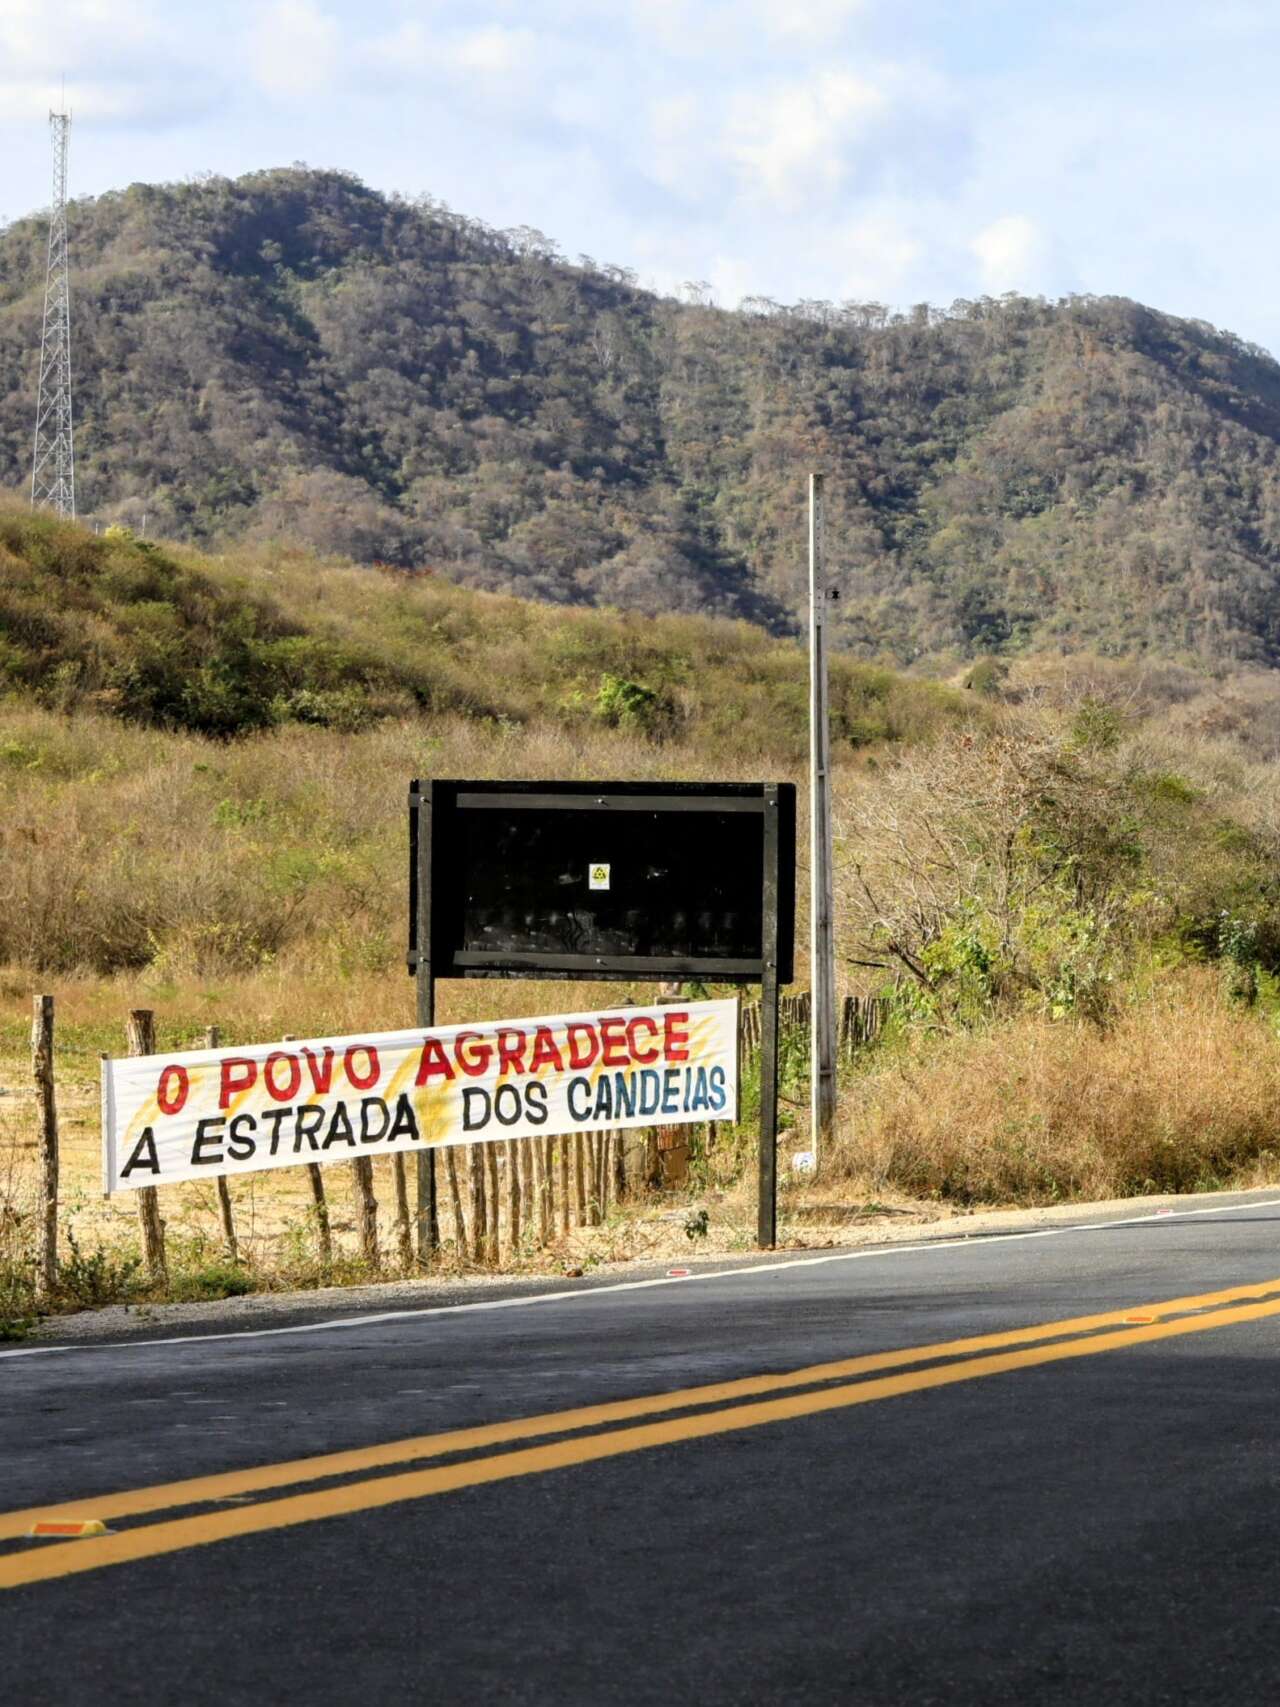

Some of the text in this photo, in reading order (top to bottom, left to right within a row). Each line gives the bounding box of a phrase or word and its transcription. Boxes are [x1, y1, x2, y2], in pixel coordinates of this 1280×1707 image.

[157, 1012, 690, 1115] O POVO AGRADECE
[120, 1065, 726, 1178] A ESTRADA DOS CANDEIAS
